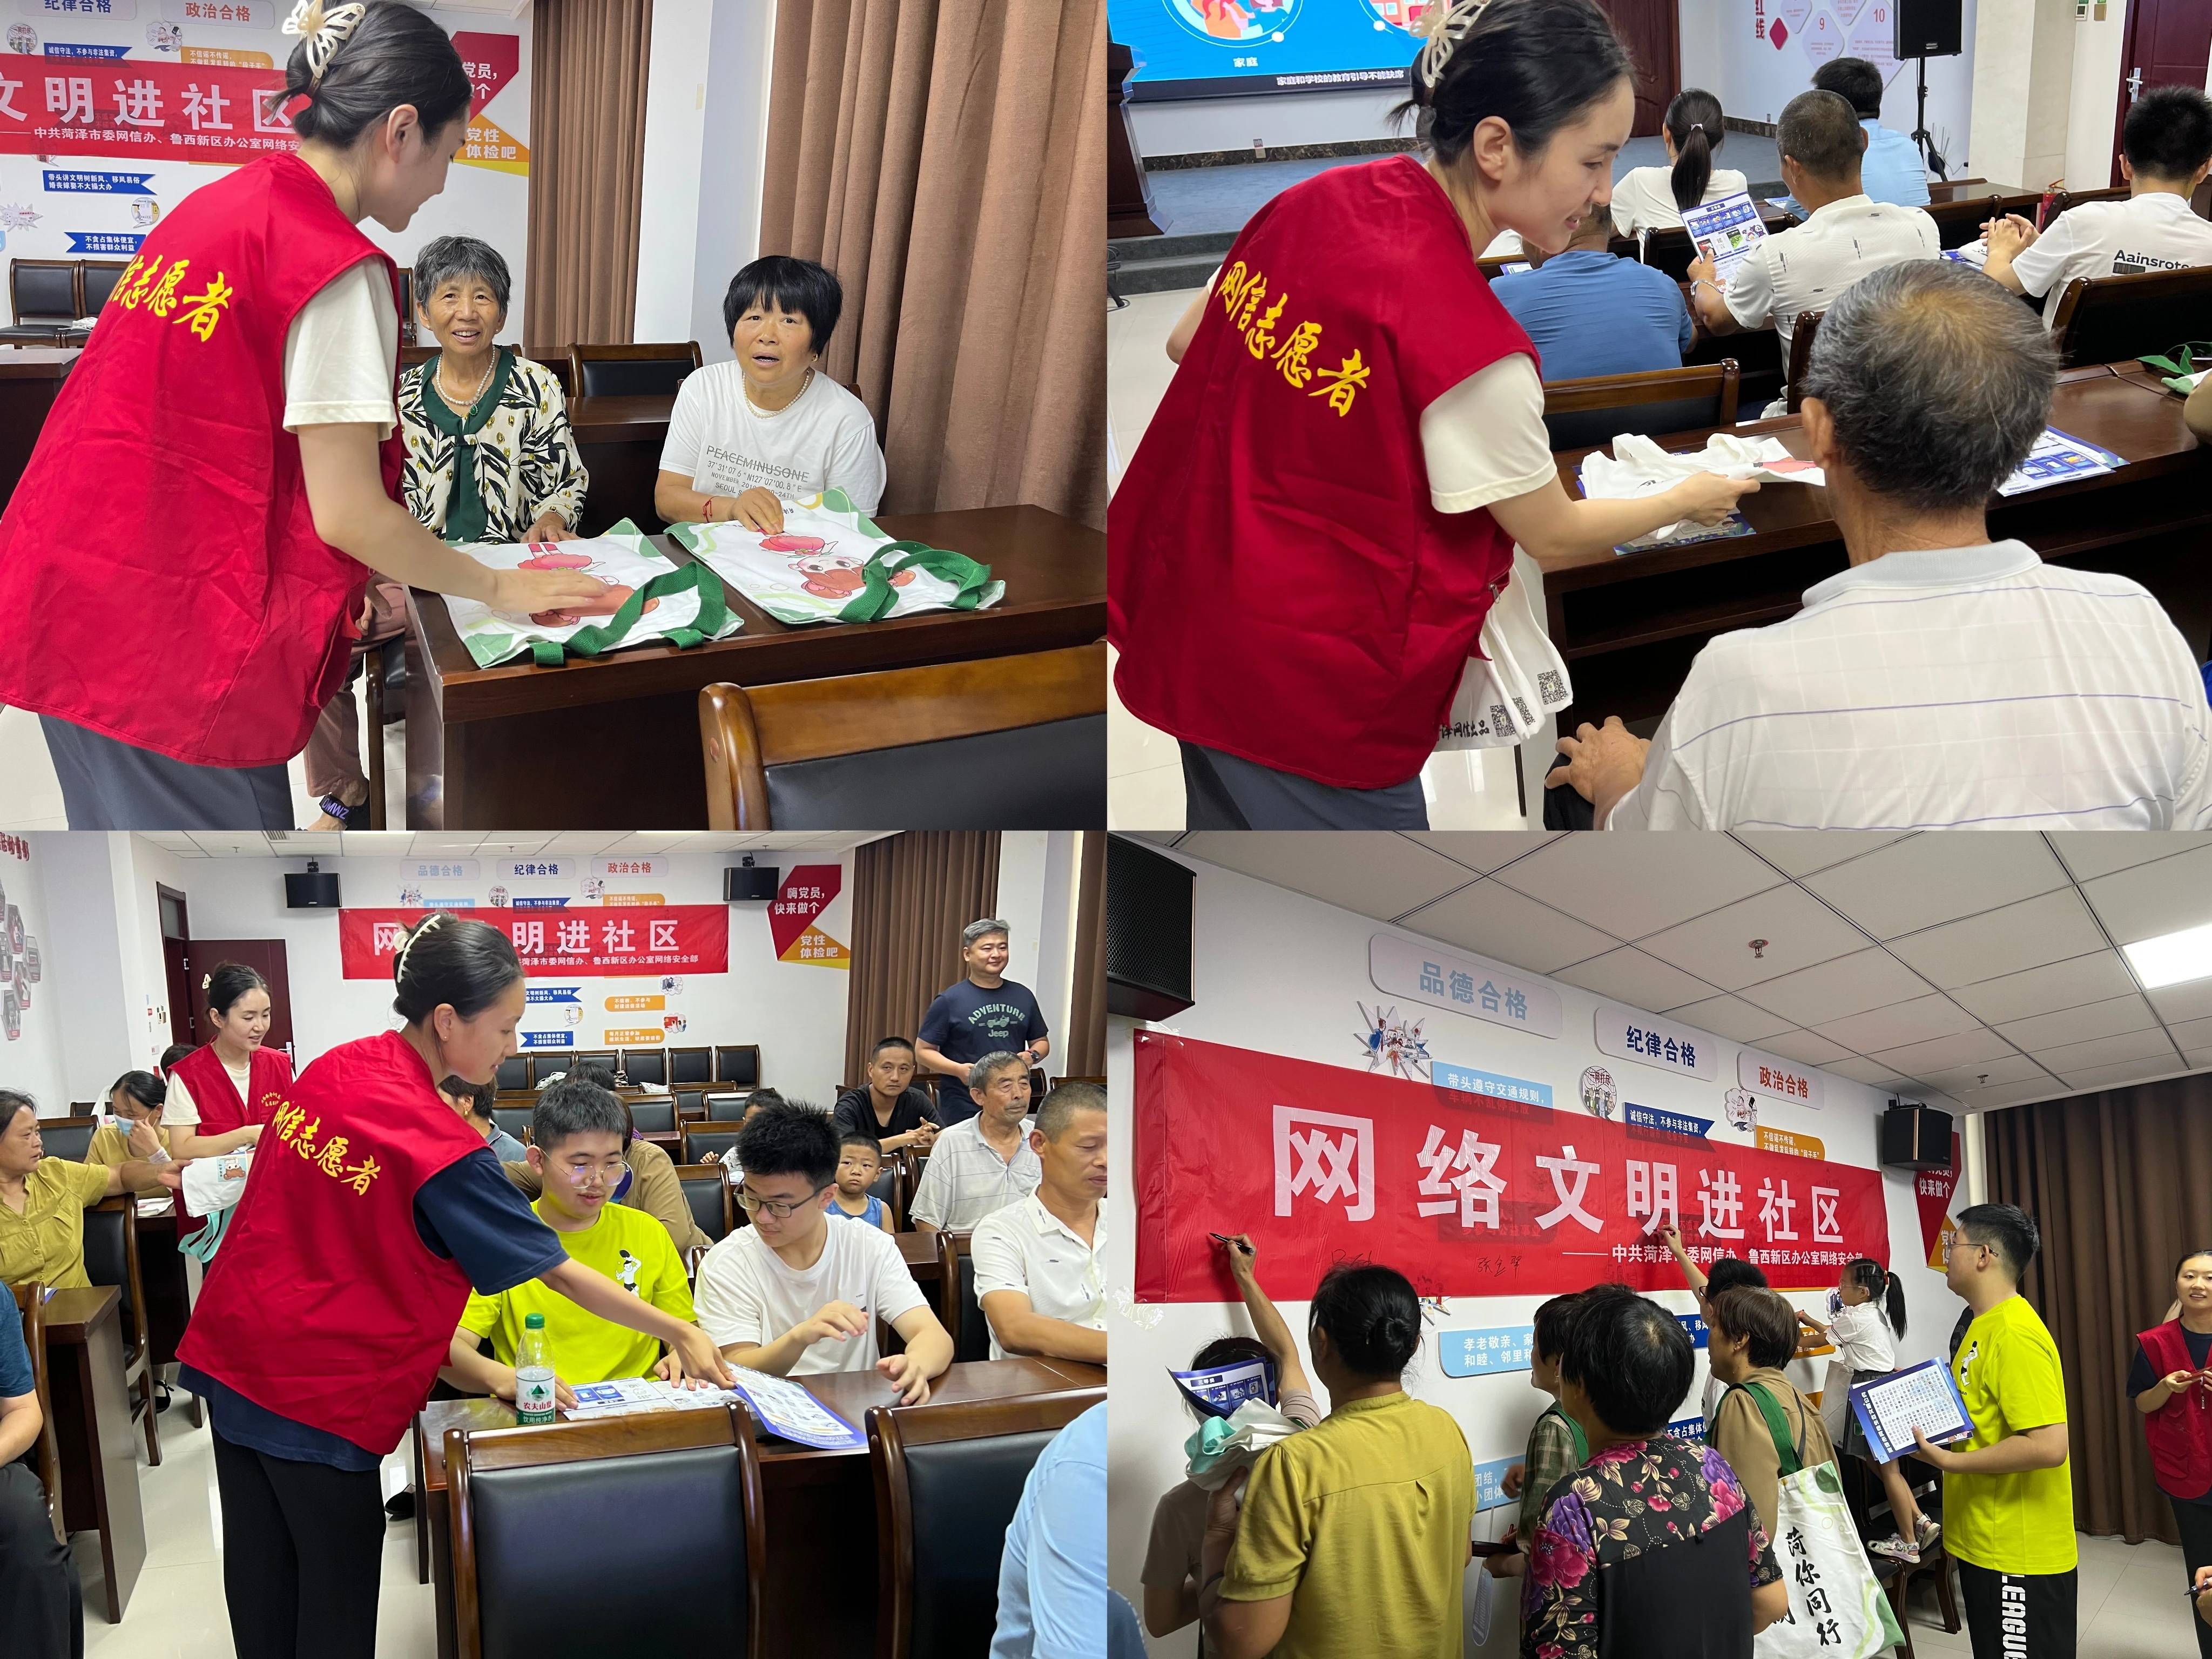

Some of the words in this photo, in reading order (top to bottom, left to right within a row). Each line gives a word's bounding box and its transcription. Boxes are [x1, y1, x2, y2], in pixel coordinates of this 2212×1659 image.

[185, 3, 251, 22] 政治合格
[1873, 8, 1885, 23] 10
[1819, 17, 1825, 30] 9
[1233, 57, 1258, 68] 家庭
[1276, 70, 1404, 85] 家庭和学校的教育引导不能缺席
[466, 127, 500, 143] 党性
[466, 144, 516, 159] 体检吧
[86, 244, 135, 252] 不损害群众利益
[1215, 261, 1371, 417] 网信志愿者
[706, 446, 810, 483] PEACEMINUSONE
[711, 471, 739, 484] NOVEMBER
[715, 482, 736, 494] SEOUL
[417, 865, 463, 877] 品德合格
[514, 864, 559, 875] 纪律合格
[608, 862, 652, 874] 政治合格
[774, 902, 820, 915] 快来做个
[800, 935, 826, 946] 党性
[800, 947, 838, 959] 体检吧
[1420, 960, 1528, 1021] 品德合格
[968, 1004, 1026, 1024] ADVENTURE
[988, 1029, 1009, 1038] Jeep
[1626, 1025, 1696, 1068] 纪律合格
[1759, 1065, 1809, 1100] 政治合格
[272, 1101, 381, 1196] 网信志愿者
[1273, 1104, 1844, 1244] 网络文明进社区
[1919, 1177, 1950, 1199] 快来做个
